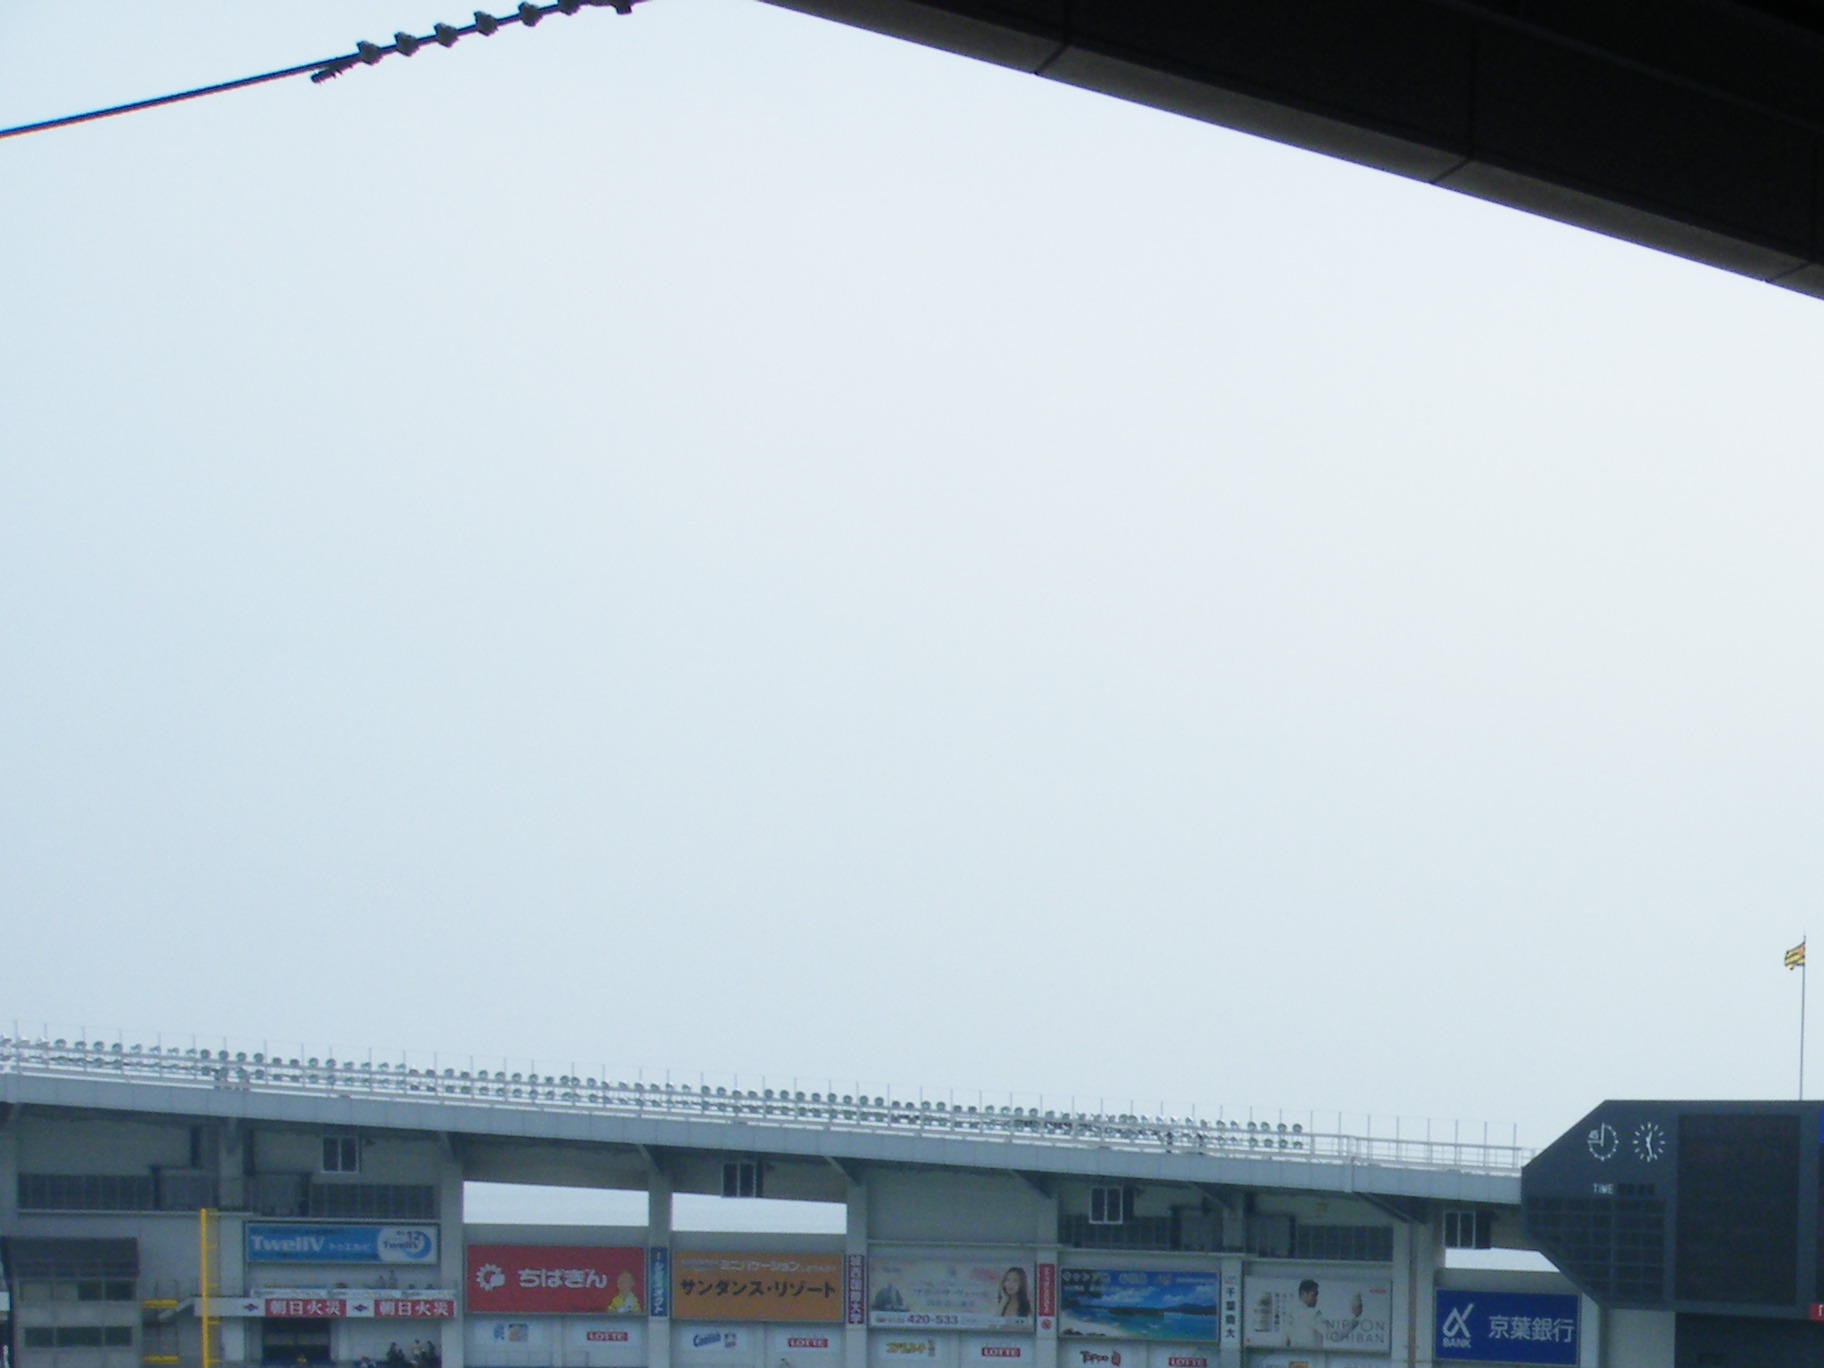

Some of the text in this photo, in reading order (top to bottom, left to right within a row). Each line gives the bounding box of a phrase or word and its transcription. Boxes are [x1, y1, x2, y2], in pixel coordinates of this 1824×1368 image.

[1593, 1183, 1614, 1195] TIME
[250, 1235, 325, 1251] TwellV
[680, 1279, 836, 1299] サンダンス・リゾート
[269, 1300, 342, 1316] 朝日火災
[379, 1300, 449, 1316] 朝日火災
[1488, 1314, 1576, 1343] 京葉銀行
[588, 1332, 627, 1341] LOTTE
[789, 1338, 828, 1348] LOTTE
[1442, 1338, 1471, 1349] BANK
[983, 1347, 1020, 1357] LOTTE
[1169, 1358, 1206, 1367] LOTTE
